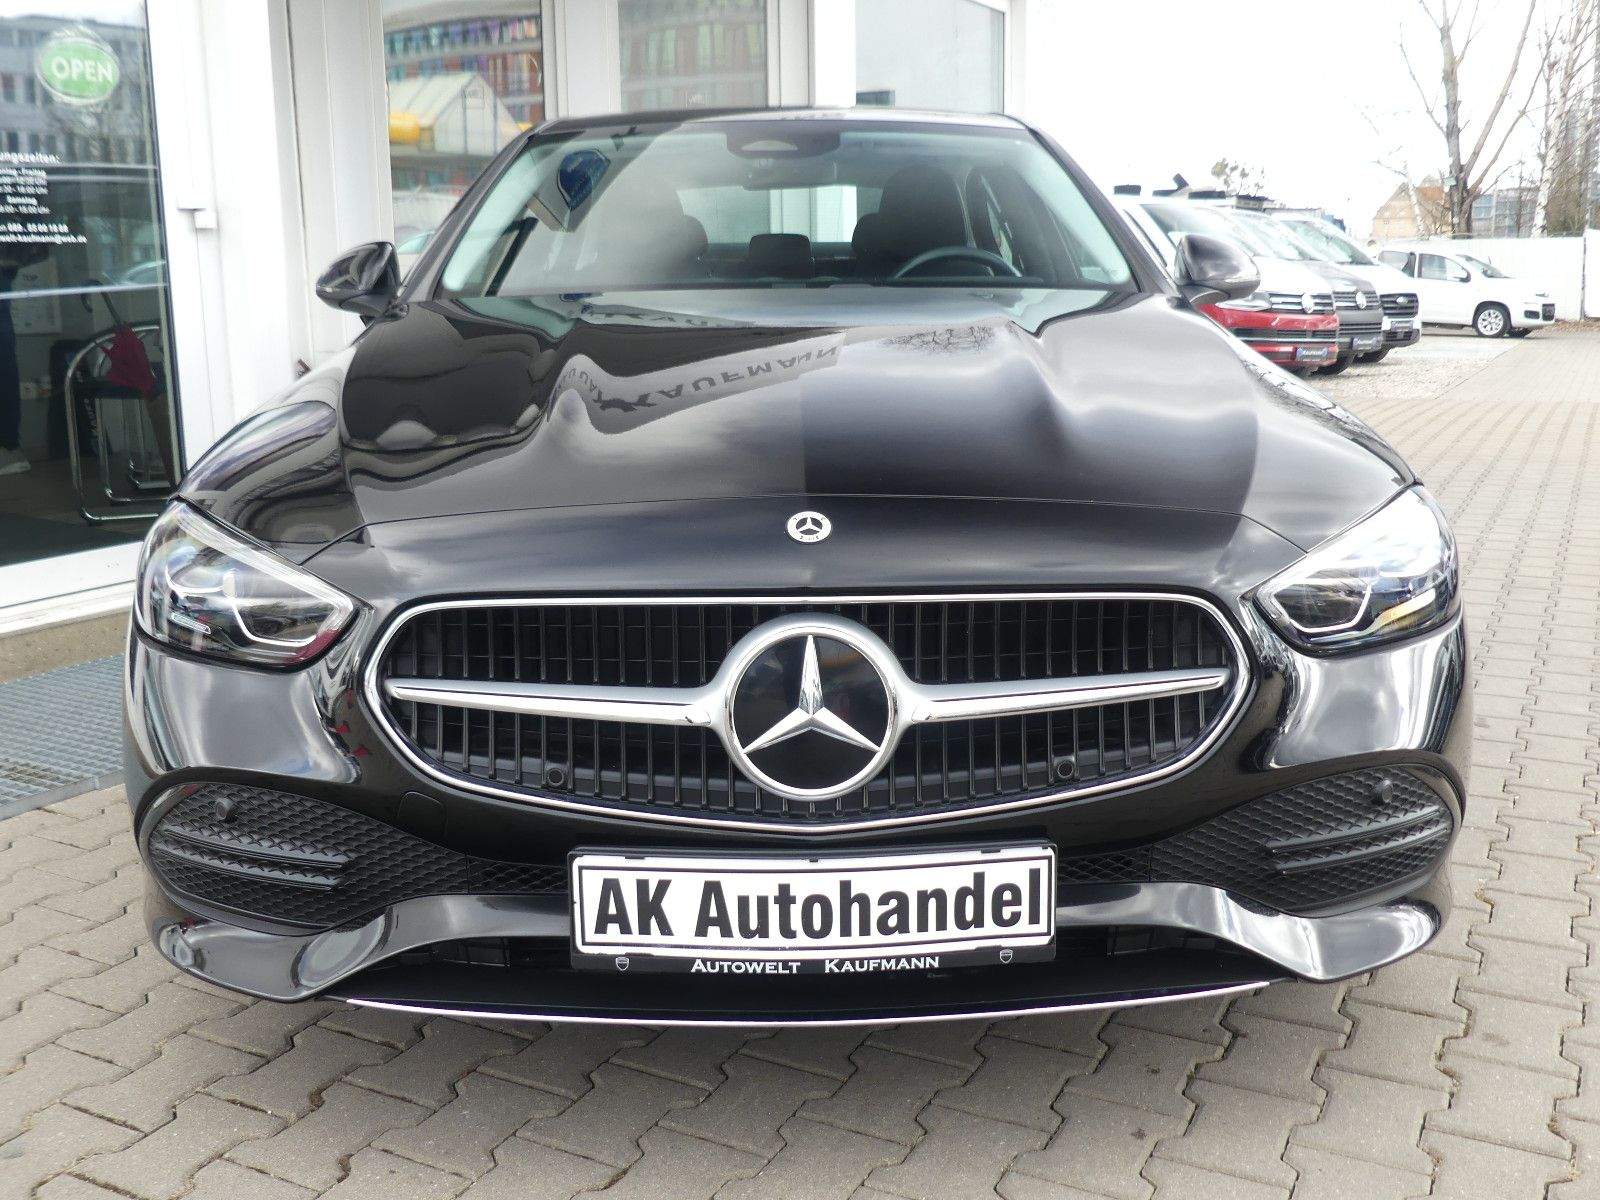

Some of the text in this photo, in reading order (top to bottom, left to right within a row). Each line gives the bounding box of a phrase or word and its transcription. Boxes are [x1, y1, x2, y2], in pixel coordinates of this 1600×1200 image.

[51, 56, 114, 83] OPEN
[593, 867, 1042, 941] AK Autohandel
